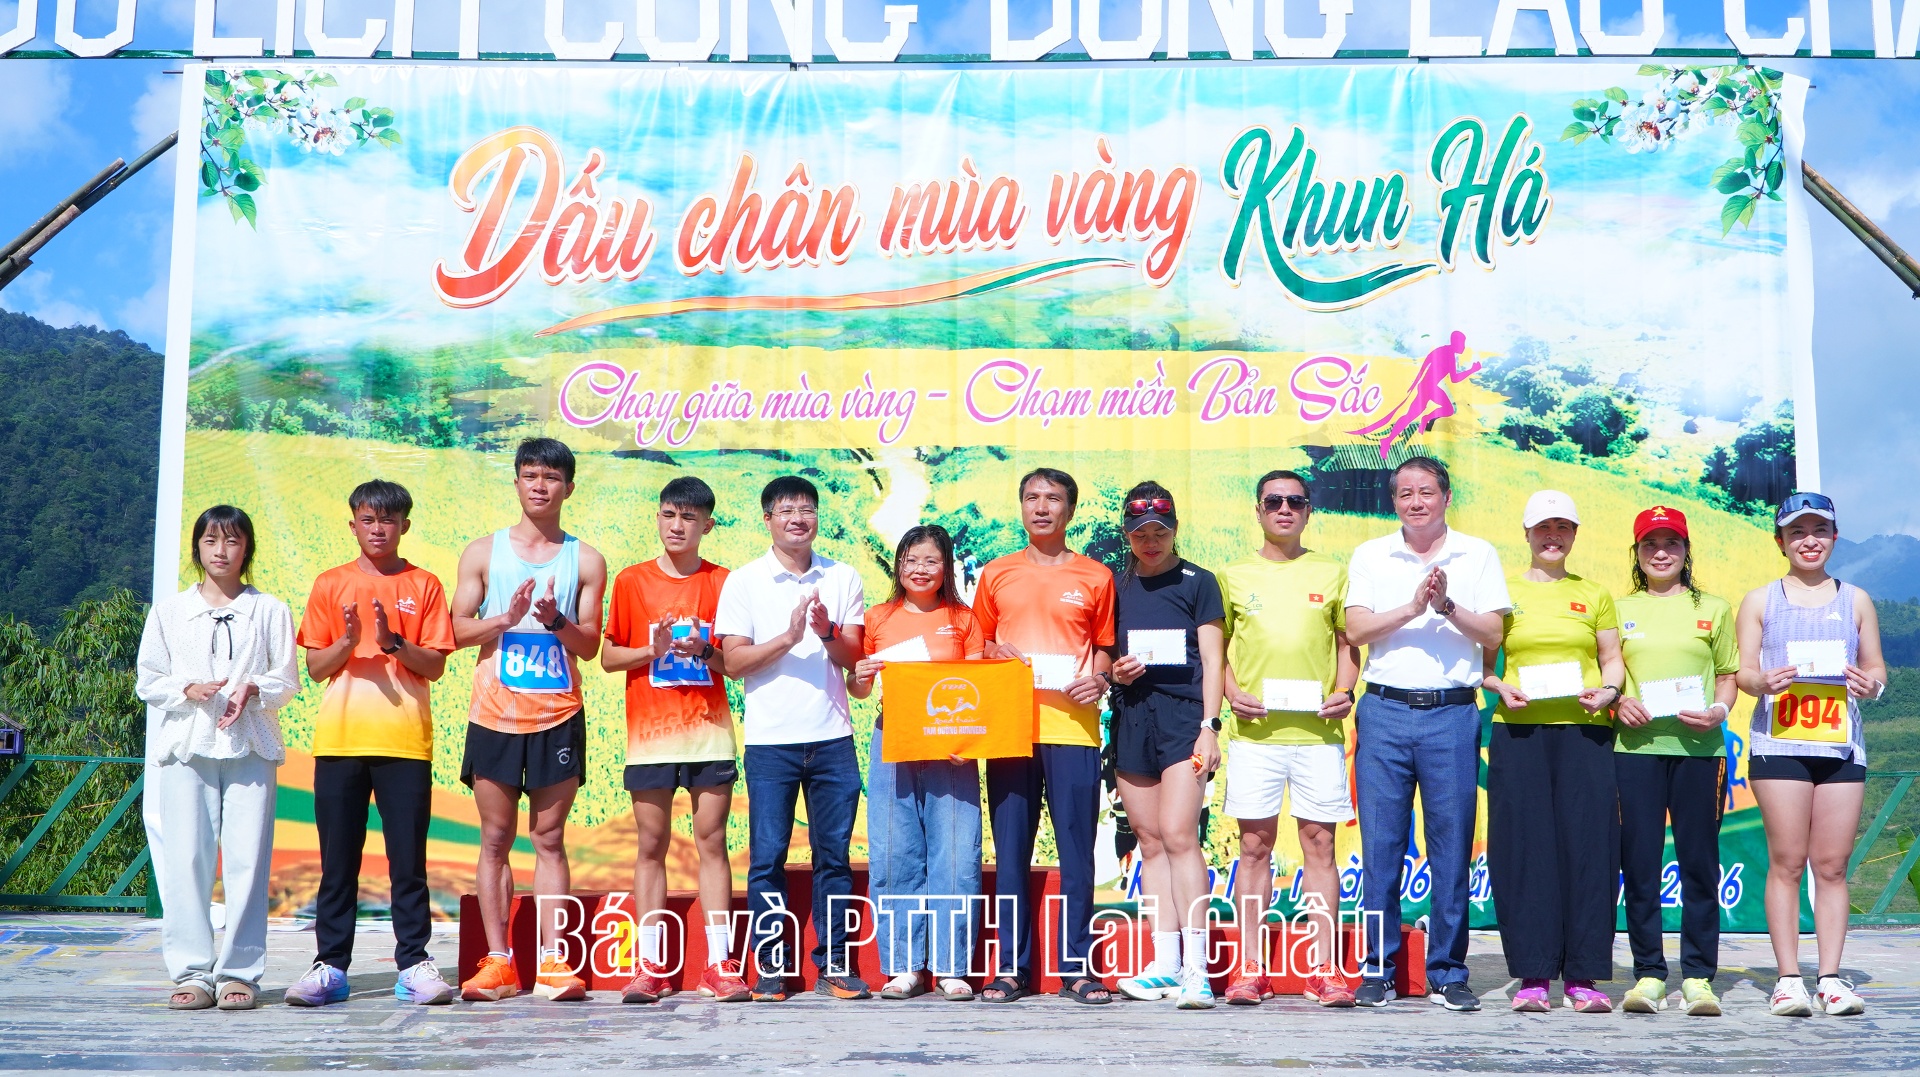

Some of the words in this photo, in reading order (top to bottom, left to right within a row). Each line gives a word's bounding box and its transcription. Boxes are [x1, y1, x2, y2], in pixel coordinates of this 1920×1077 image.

[432, 126, 658, 308] Dấu
[674, 151, 863, 276] chân
[877, 156, 1030, 258] mùa
[1042, 135, 1202, 288] vàng
[1218, 124, 1441, 312] Khun
[1425, 112, 1553, 271] Há
[558, 360, 681, 447] Chạy
[664, 380, 757, 447] giữa
[760, 371, 834, 422] mùa
[840, 370, 918, 444] vàng
[965, 358, 1093, 430] Chạm
[1097, 358, 1177, 419] miền
[1187, 356, 1280, 422] Bản
[1289, 356, 1384, 422] Sắc
[505, 643, 564, 679] 848
[639, 713, 723, 743] MARATHON
[1778, 693, 1842, 730] 094
